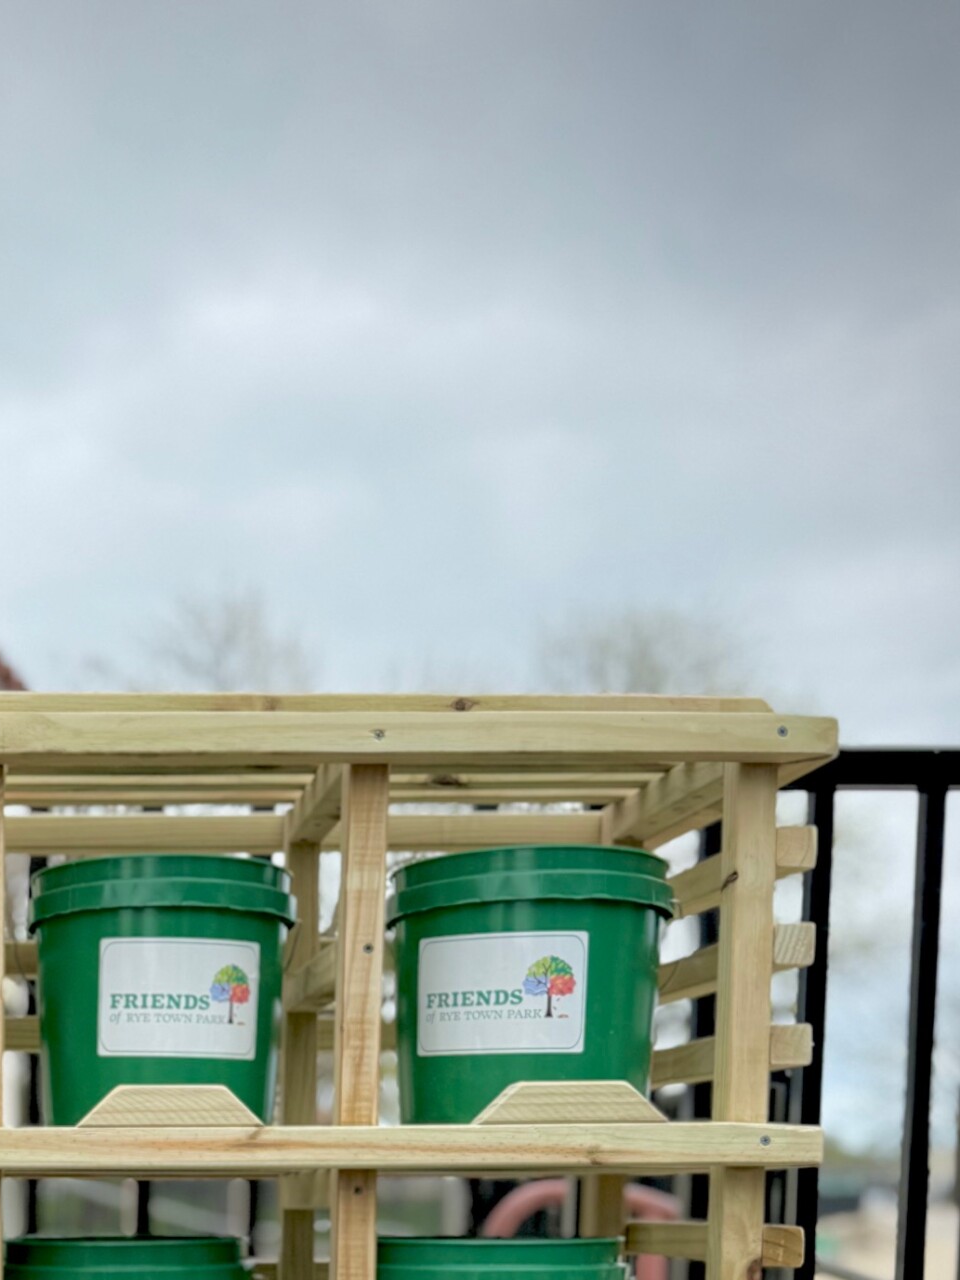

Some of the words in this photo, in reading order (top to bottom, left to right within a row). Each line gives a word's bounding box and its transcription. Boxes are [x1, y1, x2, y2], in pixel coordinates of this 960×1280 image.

[110, 993, 210, 1010] FRIENDS
[426, 989, 524, 1008] FRIENDS
[109, 1011, 122, 1024] of
[126, 1013, 151, 1023] RYE
[154, 1013, 193, 1024] TOWN
[196, 1014, 226, 1024] PARK
[425, 1010, 436, 1024] of
[440, 1011, 461, 1022] RYE
[464, 1009, 504, 1020] TOWN
[507, 1009, 543, 1019] PARK
